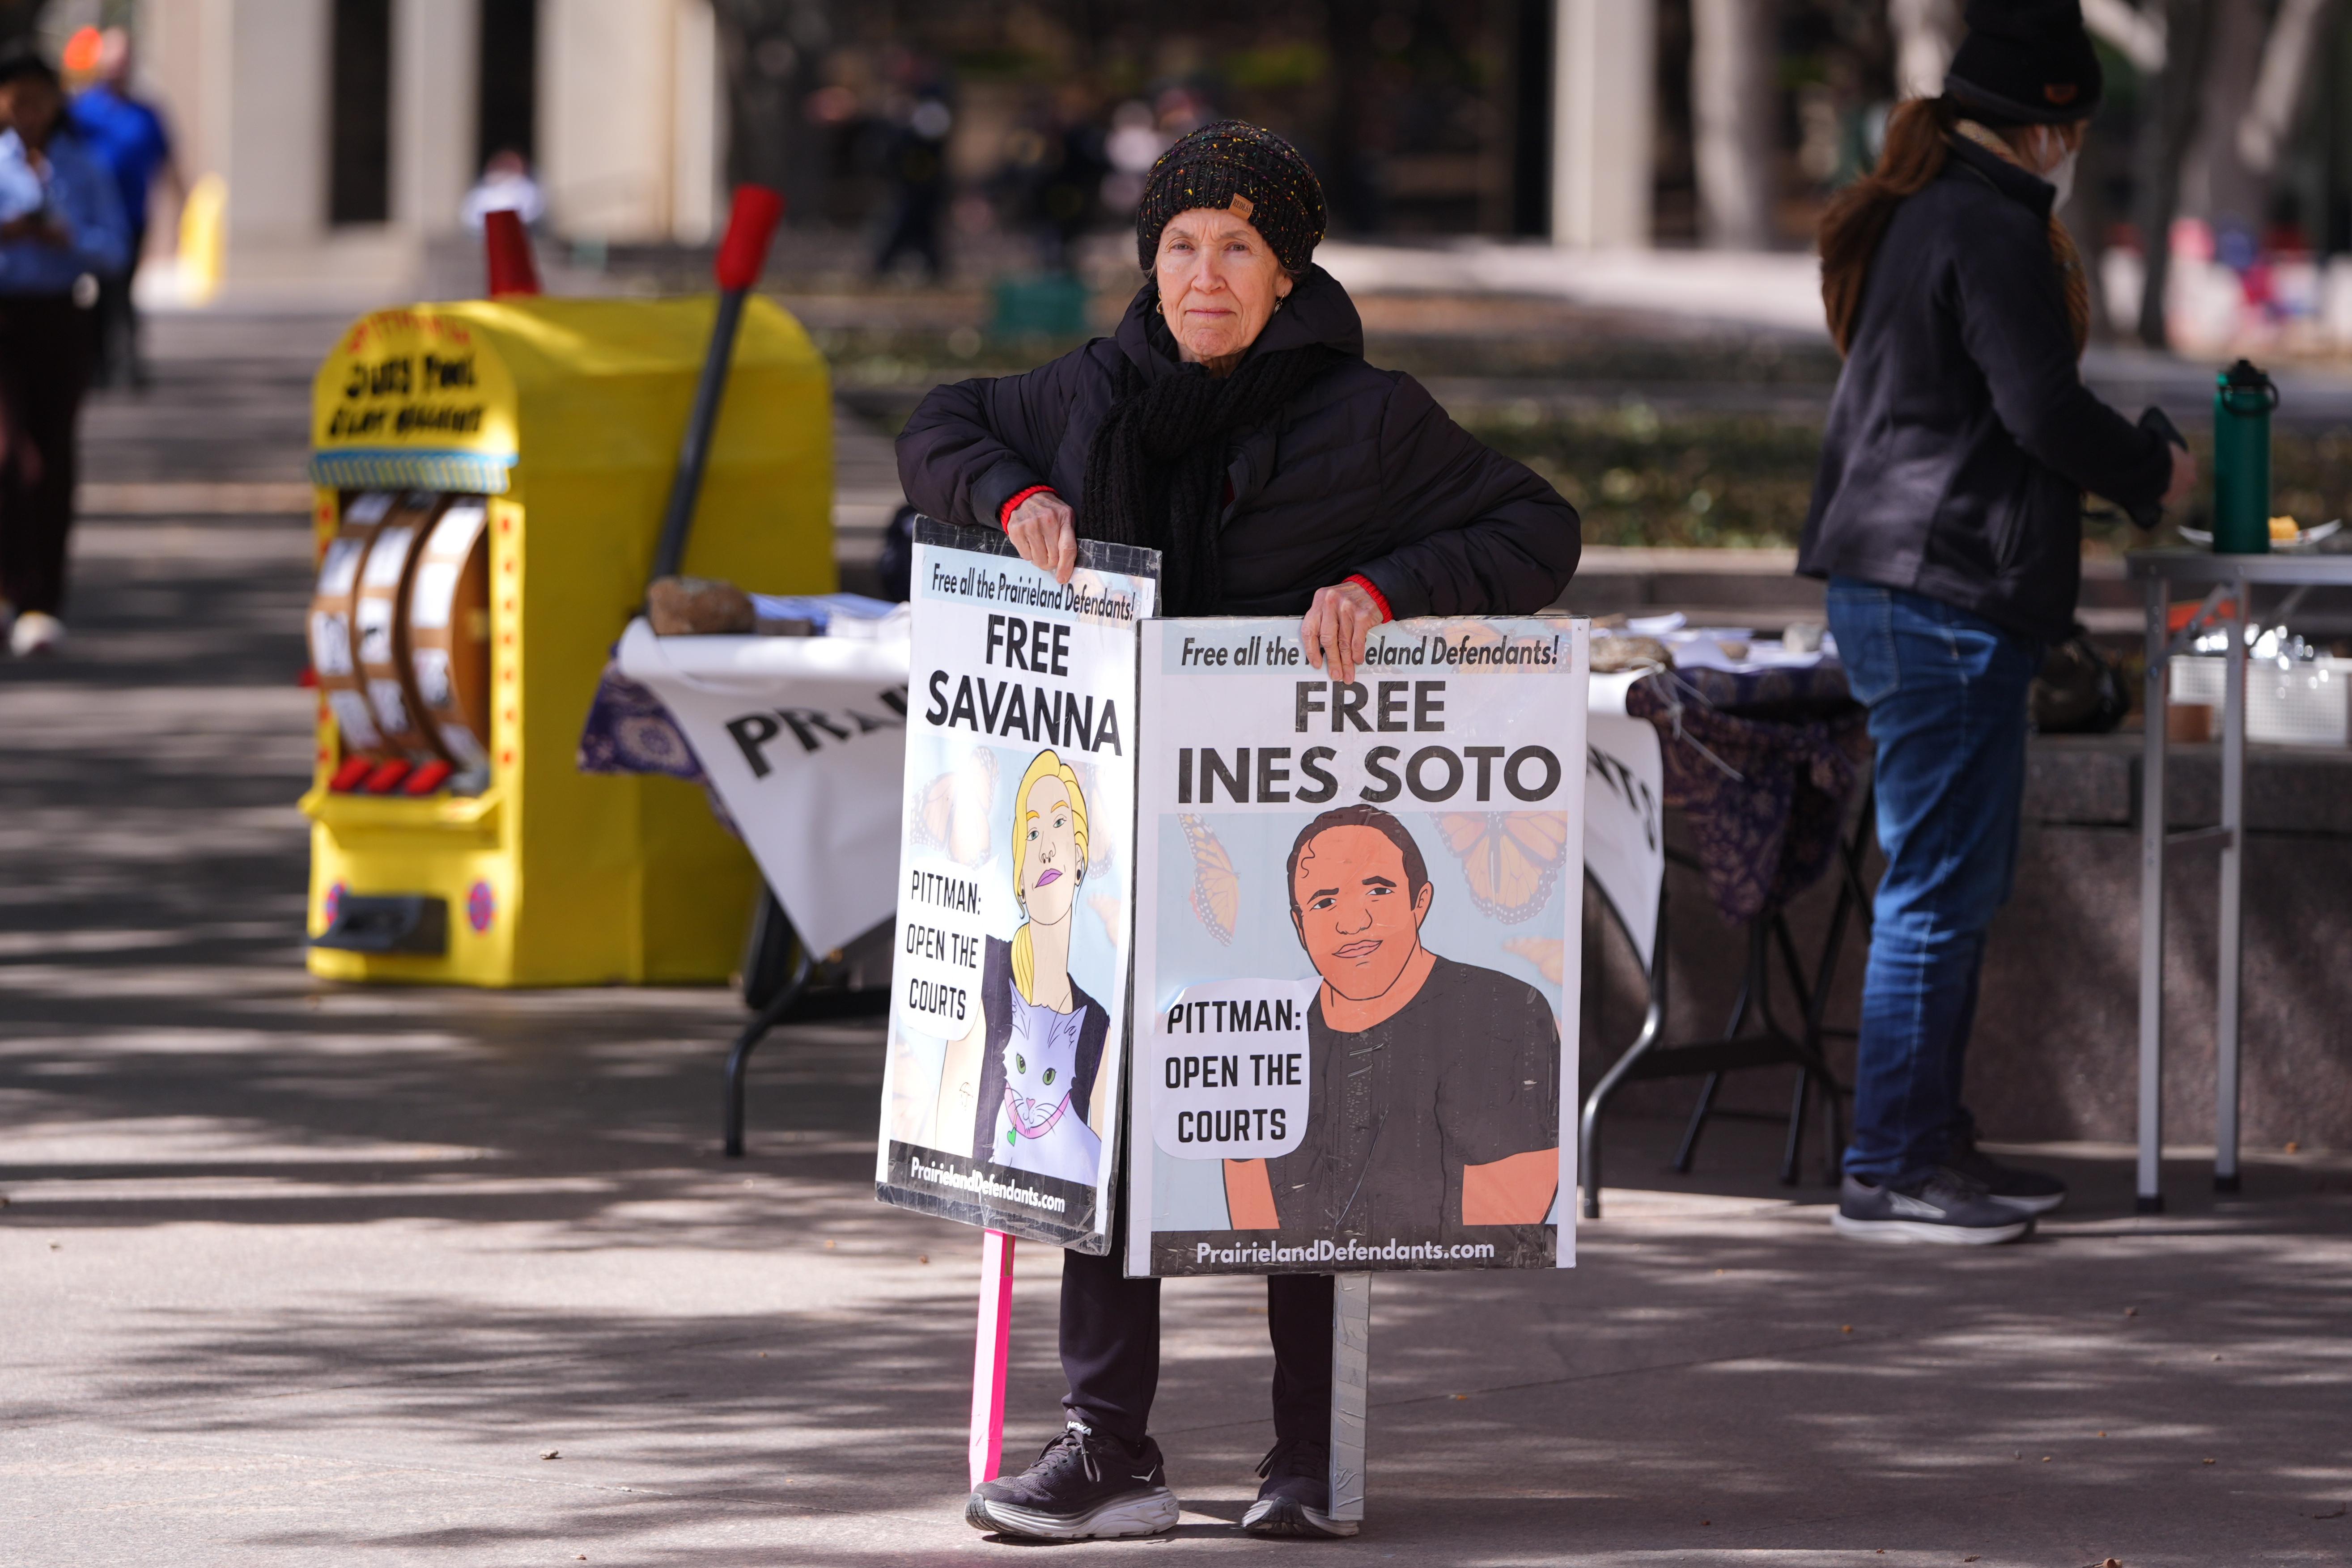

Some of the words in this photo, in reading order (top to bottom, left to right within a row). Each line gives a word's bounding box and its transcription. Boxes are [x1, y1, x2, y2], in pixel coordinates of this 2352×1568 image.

[932, 563, 957, 595] Free
[959, 567, 975, 596] all
[976, 569, 995, 600] the
[998, 573, 1062, 610] Prairieland
[1065, 583, 1136, 621] Defendants!
[985, 614, 1071, 677] FREE
[1181, 637, 1227, 666] Free
[1233, 636, 1261, 665] all
[1265, 636, 1299, 665] the
[1431, 635, 1558, 665] Defendants!
[926, 670, 1122, 756] SAVANNA
[1295, 680, 1446, 733] FREE
[1177, 746, 1338, 804] INES
[1359, 745, 1562, 803] SOTO
[911, 869, 981, 915] PITTMAN:
[906, 923, 945, 962] OPEN
[951, 933, 979, 969] THE
[909, 978, 966, 1021] COURTS
[1167, 999, 1301, 1034] PITTMAN:
[1165, 1055, 1238, 1088] OPEN
[1250, 1053, 1302, 1086] THE
[1178, 1108, 1286, 1143] COURTS
[910, 1156, 1066, 1213] PrairielandDefendants.com
[1196, 1237, 1495, 1265] PrairielandDefendants.com
